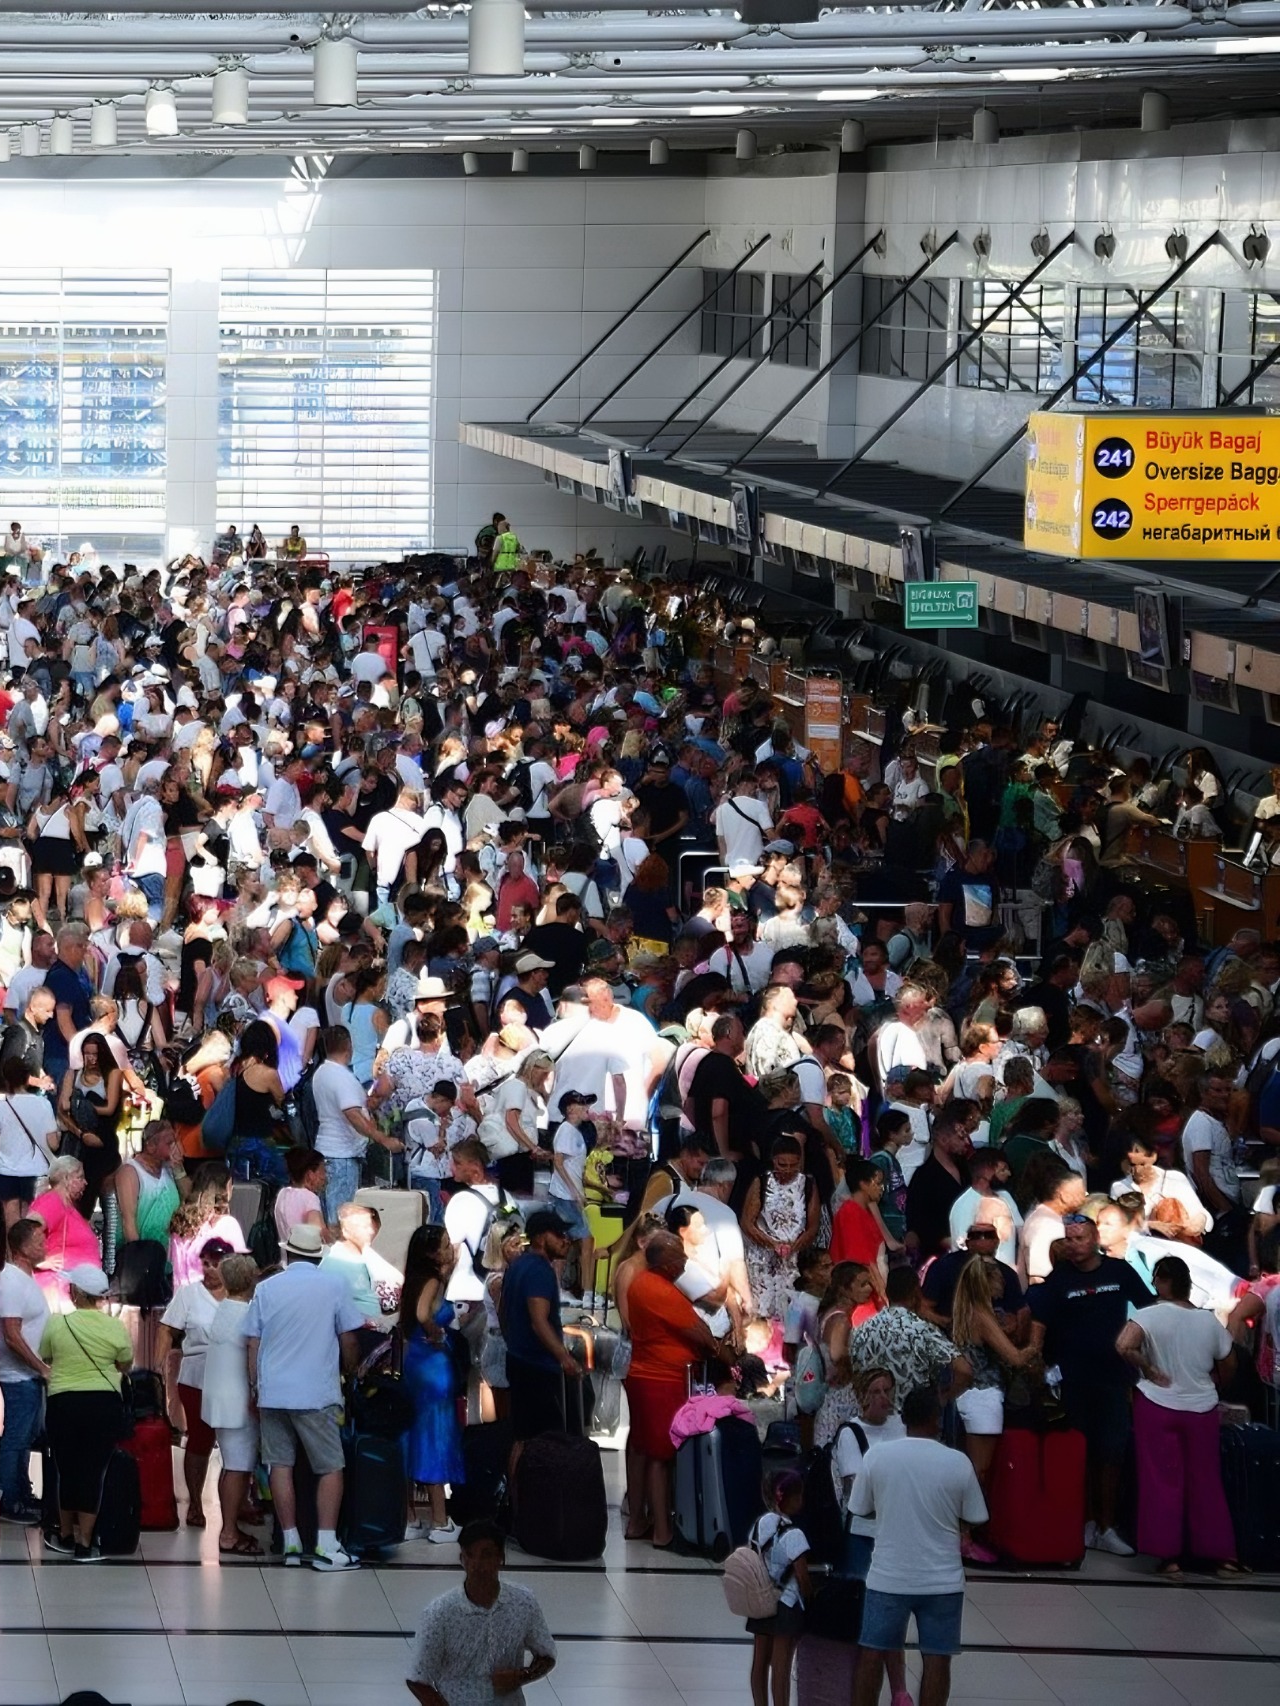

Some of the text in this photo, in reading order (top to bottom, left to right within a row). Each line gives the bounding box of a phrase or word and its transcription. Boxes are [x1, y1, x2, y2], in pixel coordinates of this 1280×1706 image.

[1146, 430, 1262, 454] Büyük Bagaj
[1097, 449, 1132, 467] 241
[1145, 462, 1280, 485] Oversize Bagg
[1094, 511, 1131, 528] 242
[1142, 523, 1271, 545] негабаритный
